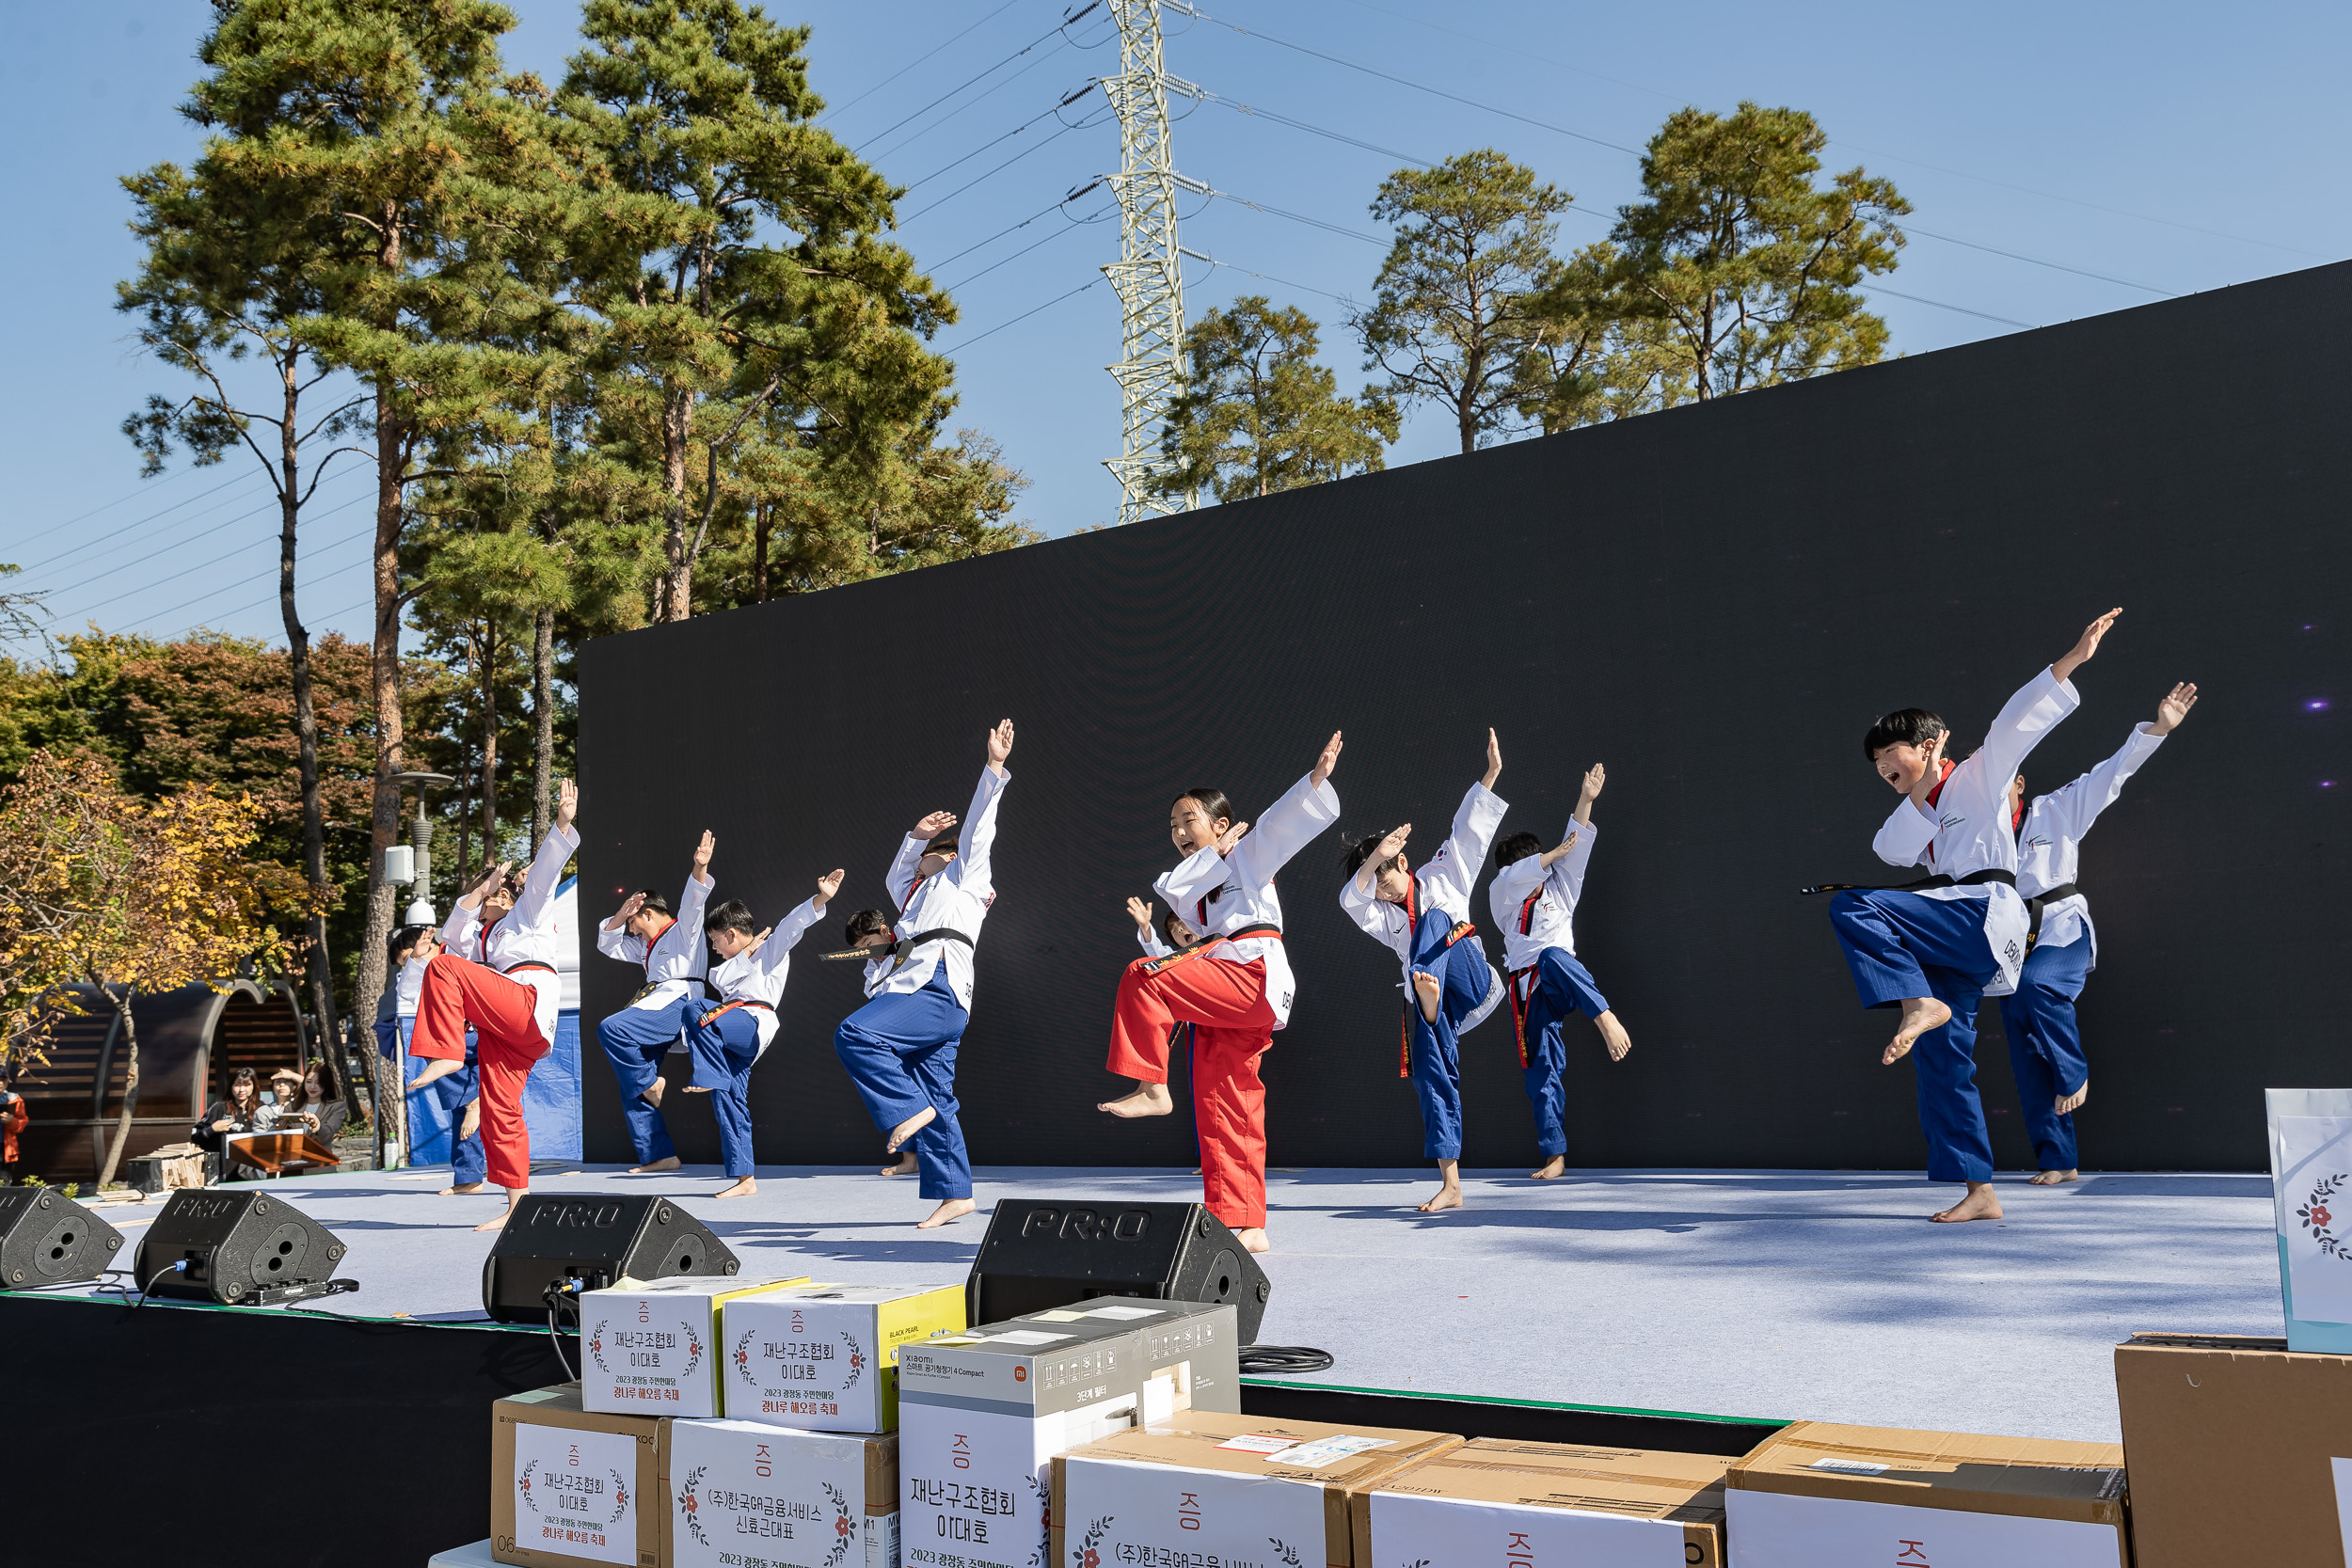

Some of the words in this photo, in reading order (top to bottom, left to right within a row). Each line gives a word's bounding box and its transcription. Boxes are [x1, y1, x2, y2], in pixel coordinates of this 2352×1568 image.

[531, 1200, 625, 1228] PR:O
[1022, 1207, 1153, 1241] PR:O
[638, 1301, 650, 1323] 증
[791, 1310, 804, 1334] 증
[889, 1329, 904, 1338] BLACK
[905, 1325, 919, 1335] PEARL
[614, 1331, 676, 1349] 재난구조협회
[630, 1352, 661, 1368] 이대호
[763, 1342, 834, 1361] 재난구조협회
[615, 1374, 631, 1384] 2023
[781, 1364, 818, 1381] 이대호
[906, 1363, 923, 1371] 스마트
[925, 1364, 953, 1375] 공기청정기
[953, 1367, 958, 1375] 4
[958, 1368, 985, 1378] Compact
[613, 1386, 637, 1400] 광나루
[638, 1387, 661, 1401] 해오름
[663, 1388, 679, 1402] 축제
[764, 1388, 782, 1398] 2023
[761, 1401, 788, 1414] 광나루
[790, 1402, 818, 1416] 해오름
[819, 1402, 838, 1417] 축제
[568, 1444, 580, 1466] 증
[755, 1444, 772, 1478] 증
[951, 1433, 971, 1470] 증
[544, 1472, 604, 1495] 재난구조협회
[559, 1494, 589, 1512] 이대호
[911, 1478, 1016, 1518] 재난구조협회
[544, 1514, 560, 1524] 2023
[1178, 1492, 1202, 1531] 증
[542, 1526, 564, 1541] 광나루
[565, 1528, 589, 1544] 해오름
[590, 1532, 606, 1547] 축제
[736, 1514, 795, 1540] 신효근대표
[937, 1514, 990, 1544] 이대호
[498, 1534, 515, 1553] 06
[719, 1551, 742, 1566] 2023
[911, 1547, 936, 1563] 2023
